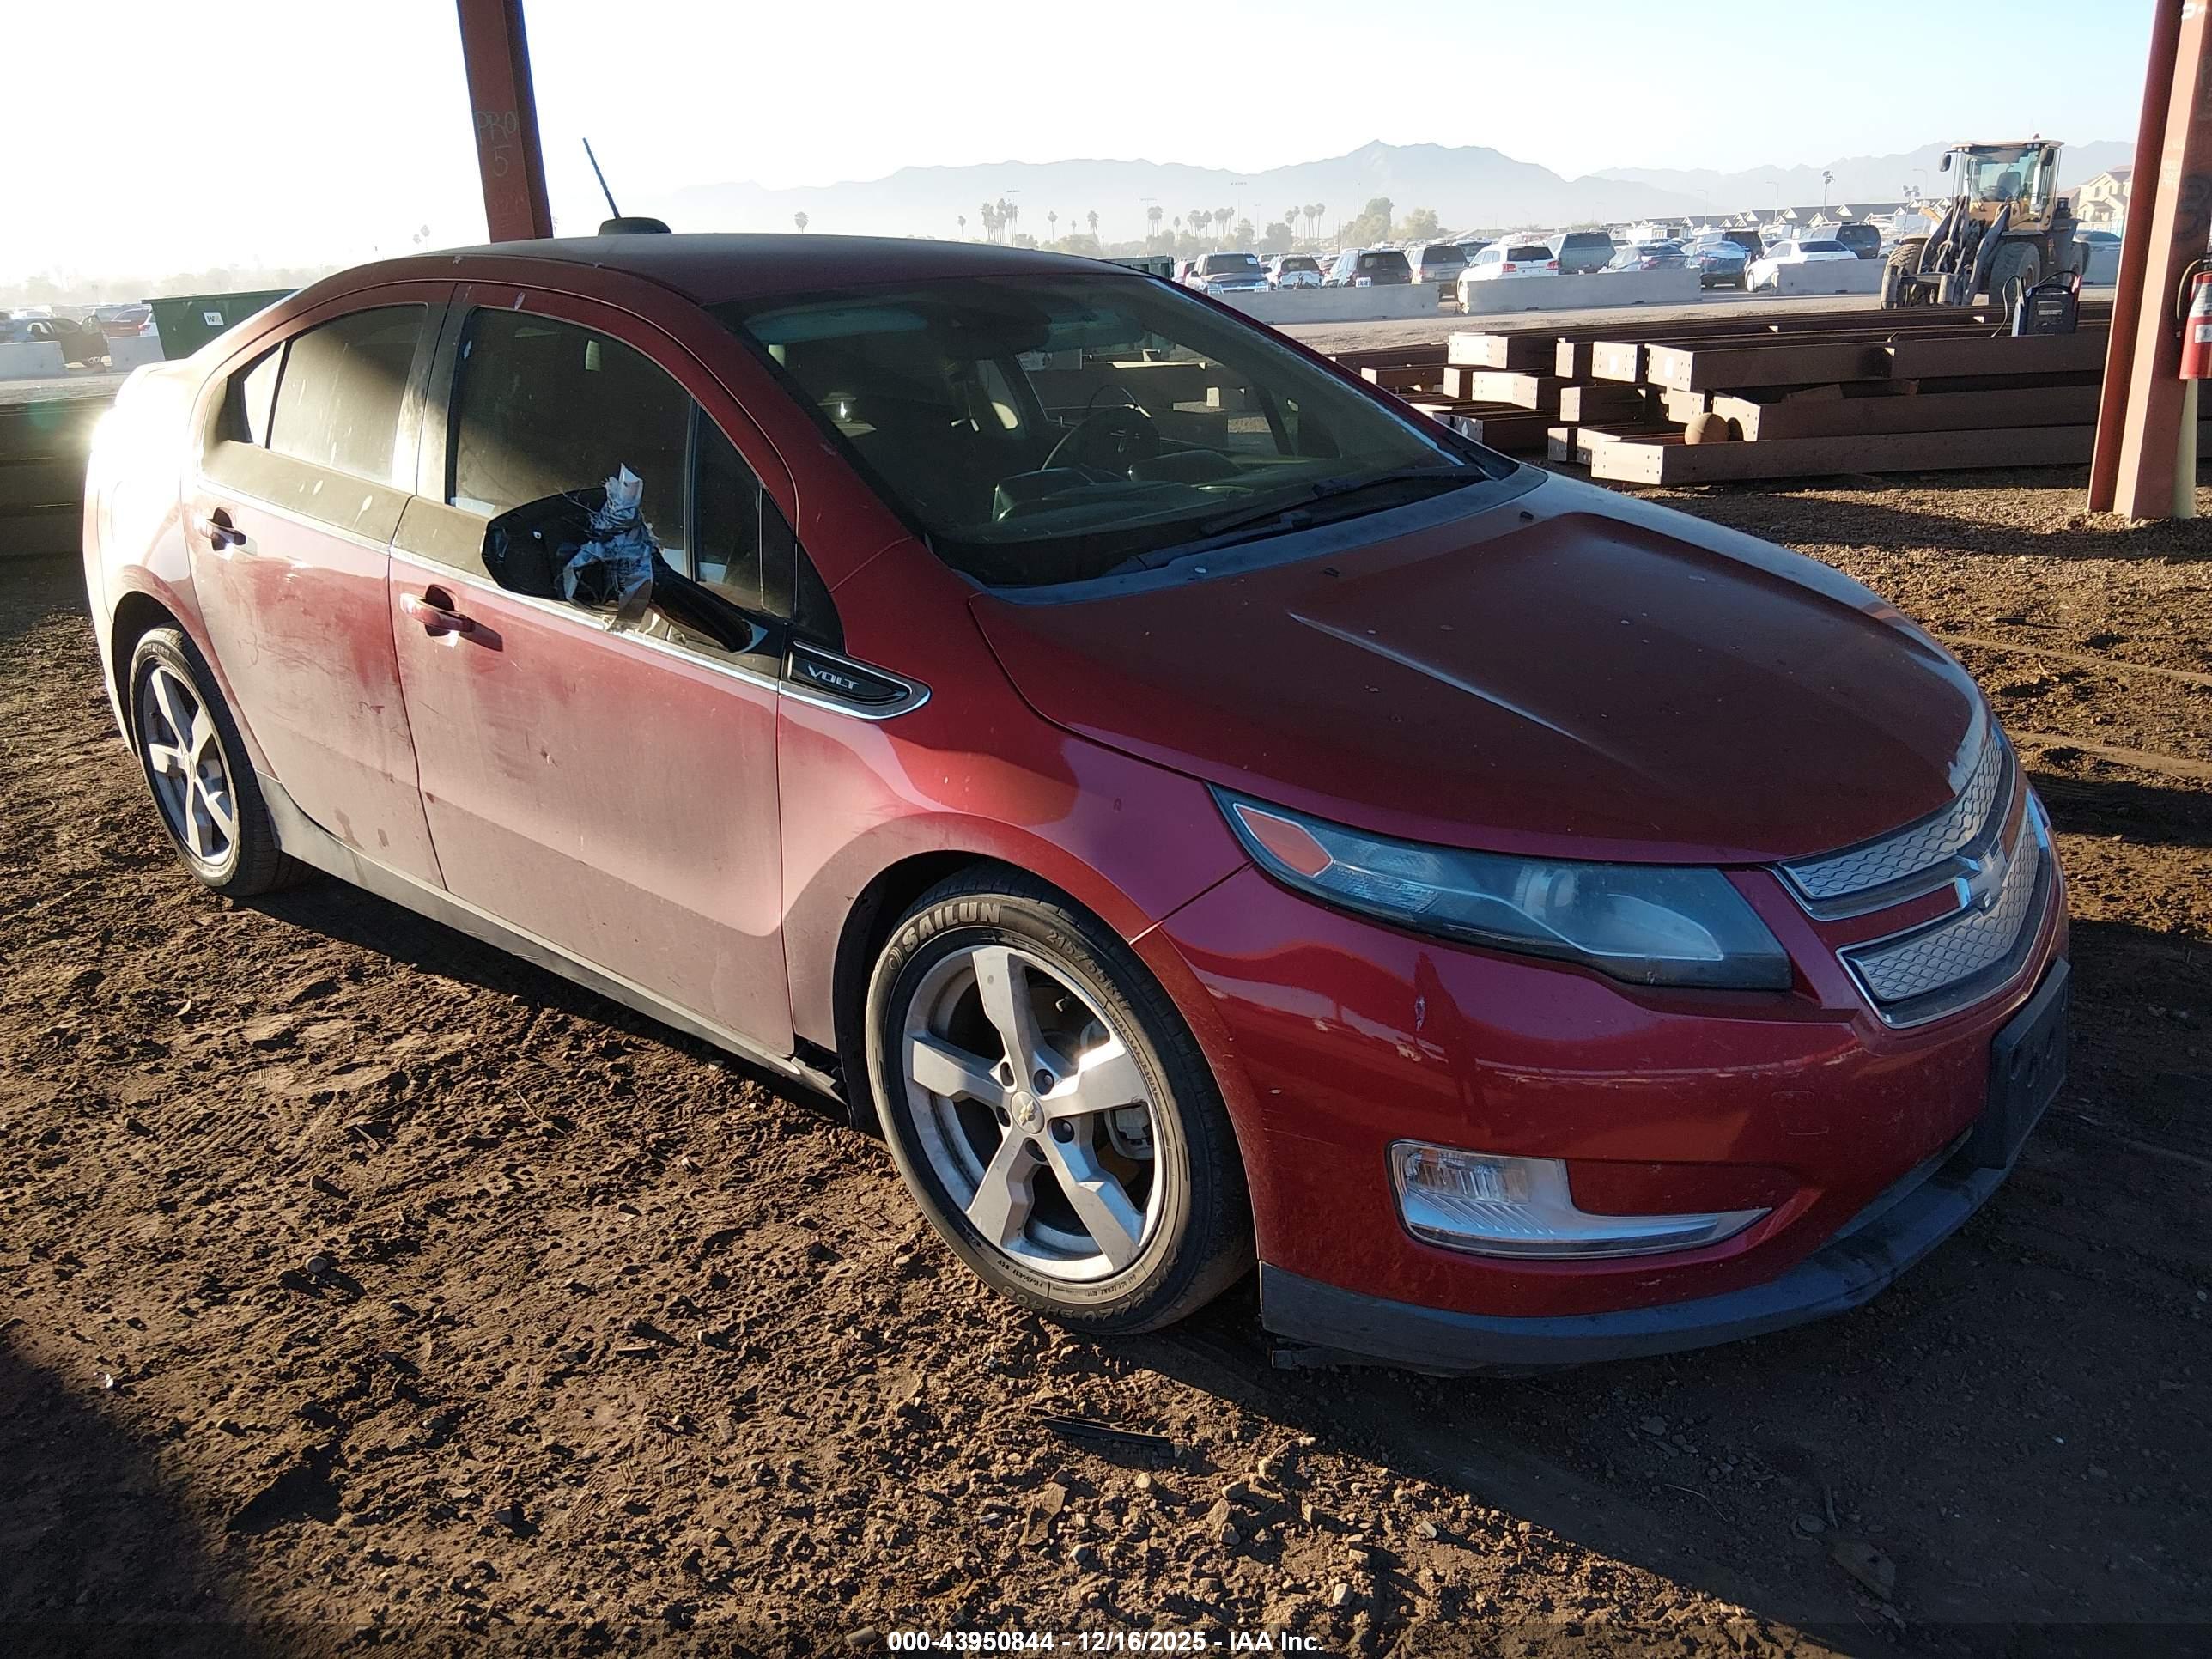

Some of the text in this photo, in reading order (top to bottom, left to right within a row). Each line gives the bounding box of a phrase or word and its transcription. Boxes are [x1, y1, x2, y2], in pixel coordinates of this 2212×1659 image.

[494, 145, 512, 177] 5
[807, 664, 859, 690] VOLT
[902, 902, 1001, 953] SAILUN
